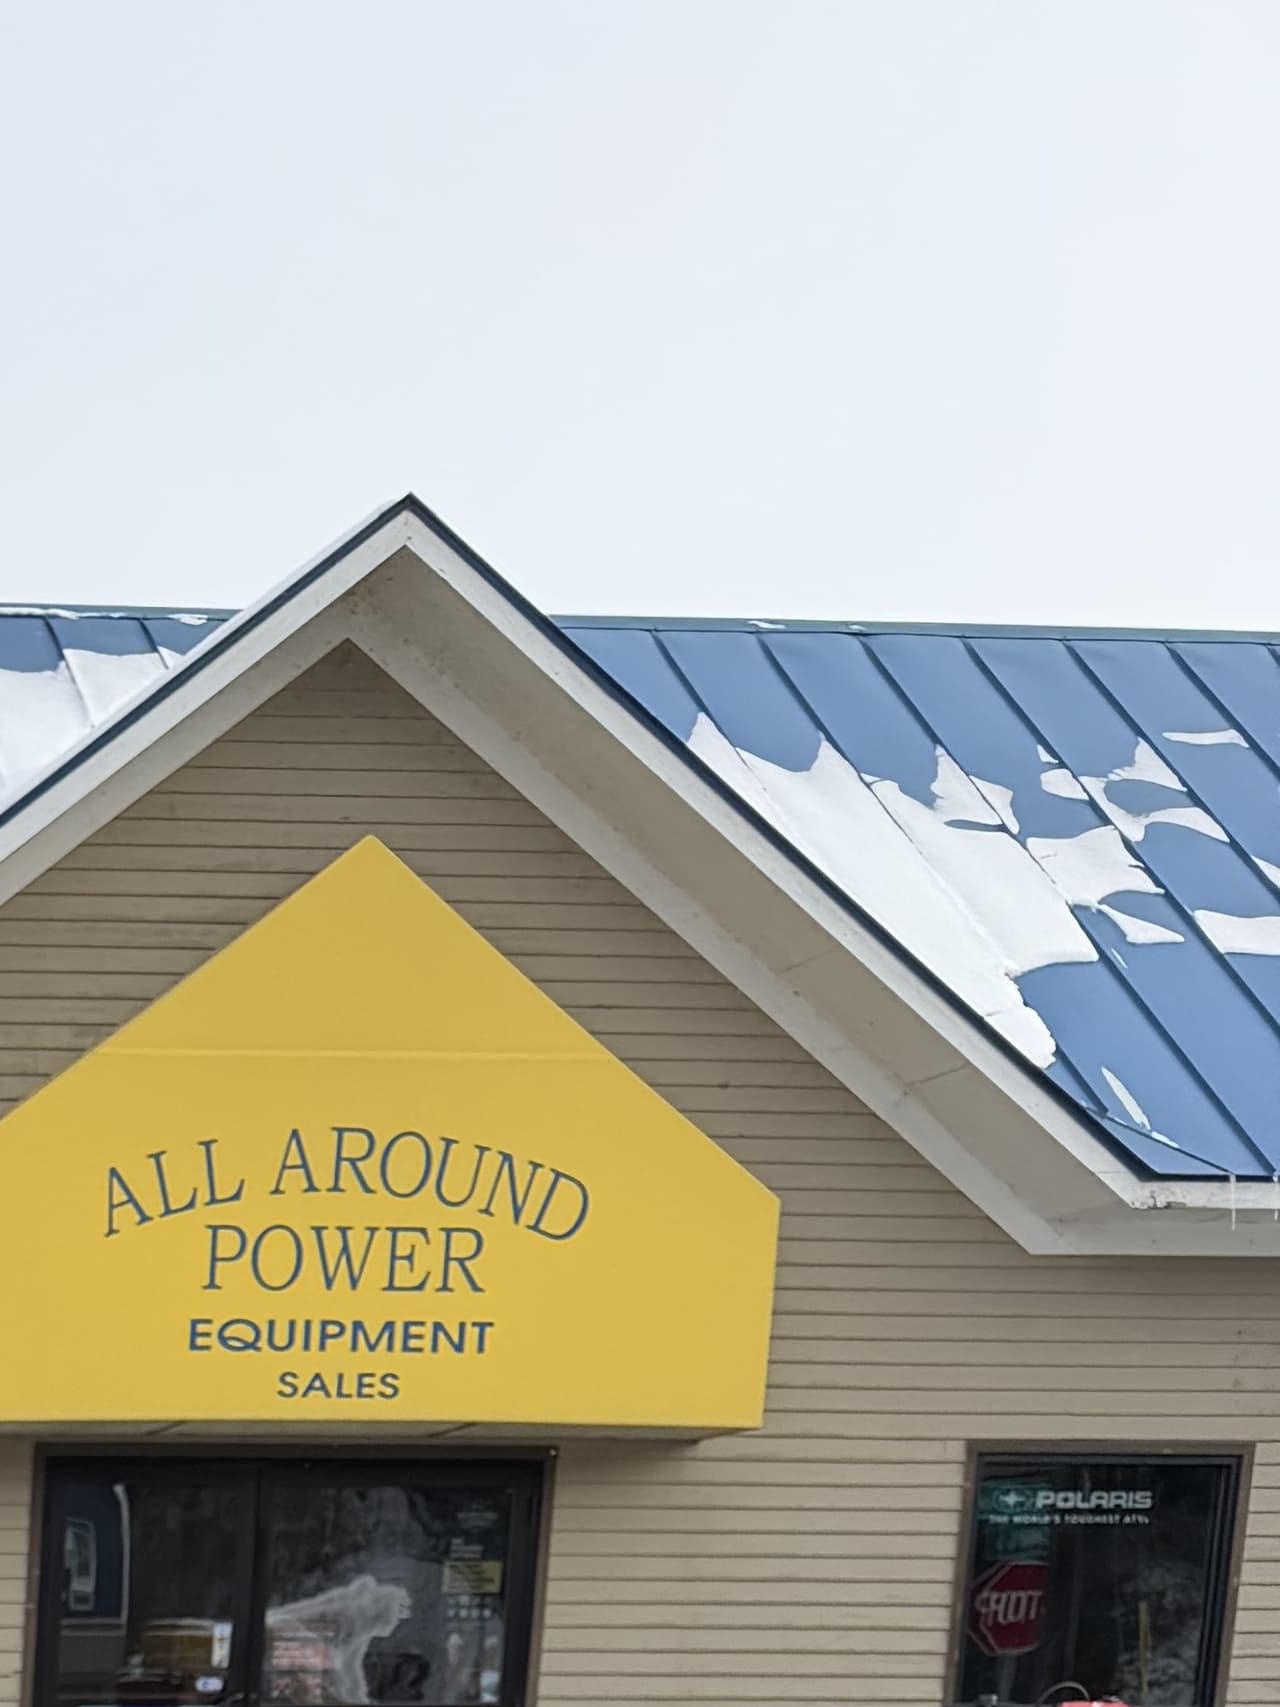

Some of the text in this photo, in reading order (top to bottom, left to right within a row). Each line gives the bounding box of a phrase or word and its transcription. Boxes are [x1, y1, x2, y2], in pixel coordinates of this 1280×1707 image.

[101, 1125, 590, 1242] ALL AROUND
[200, 1223, 487, 1295] POWER
[187, 1318, 495, 1355] EQUIPMENT
[275, 1371, 401, 1400] SALES
[1034, 1490, 1153, 1510] POLARIS
[988, 1514, 1009, 1524] THE
